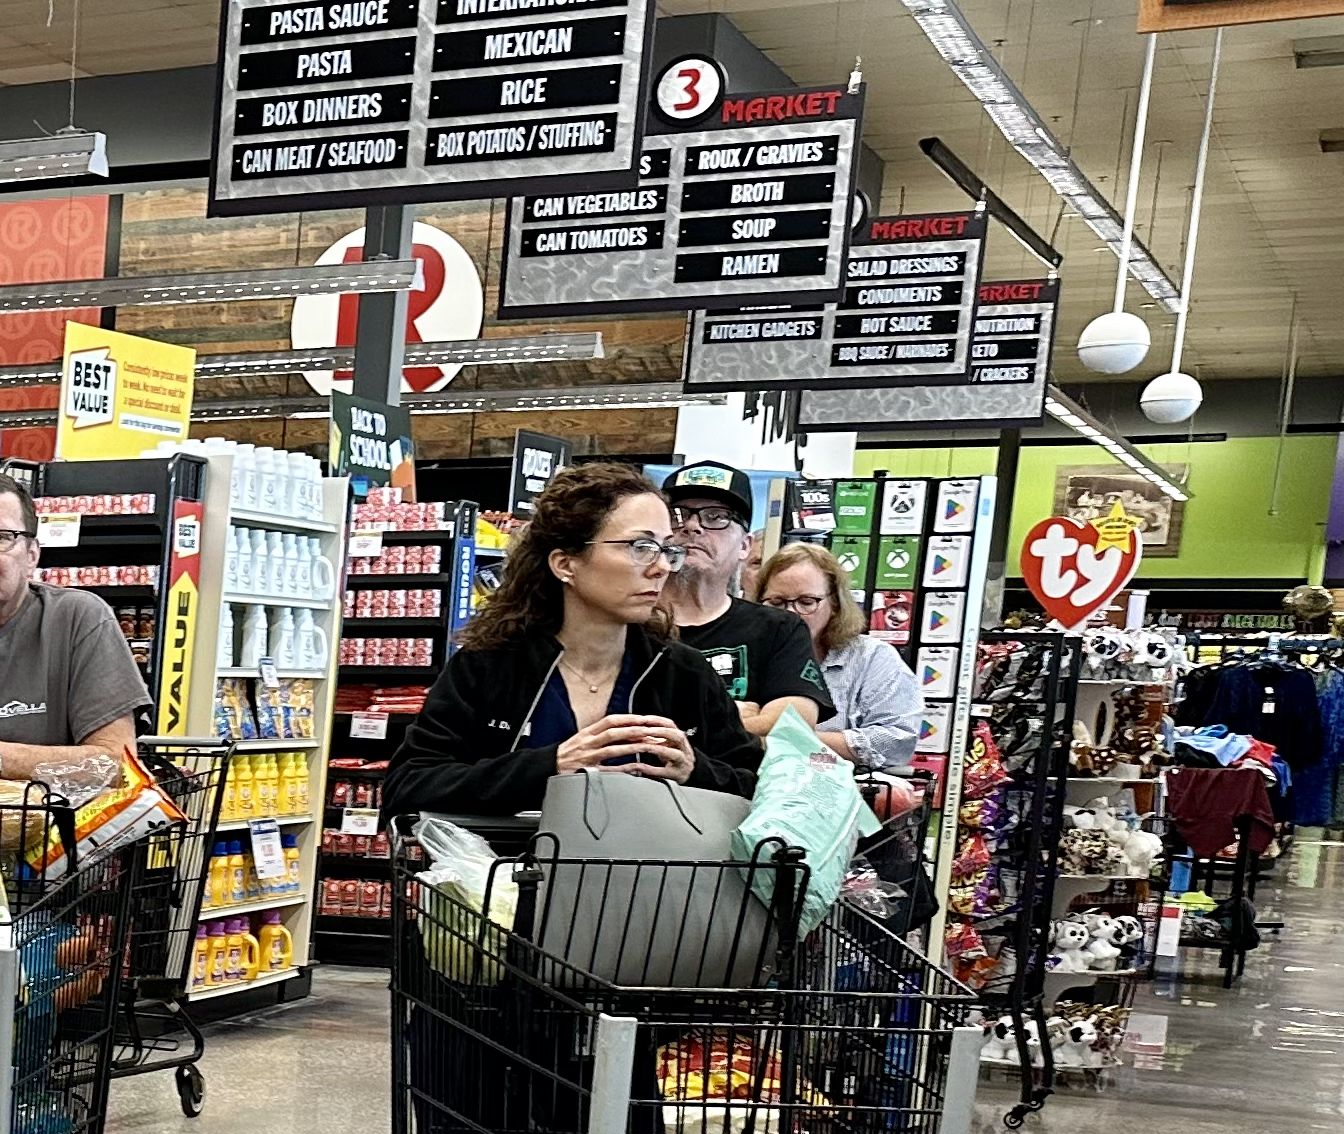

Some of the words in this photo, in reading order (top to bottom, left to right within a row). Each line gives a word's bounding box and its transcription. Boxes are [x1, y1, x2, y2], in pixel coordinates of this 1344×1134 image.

[269, 7, 325, 35] PASTA
[329, 0, 389, 29] SAUCE
[484, 27, 573, 60] MEXICAN
[296, 50, 352, 78] PASTA
[500, 77, 547, 106] RICE
[672, 68, 701, 112] 3
[262, 100, 298, 126] BOX
[301, 93, 382, 122] DINNERS
[721, 91, 843, 124] MARKET
[437, 132, 463, 158] BOX
[466, 127, 526, 154] POTATOS
[526, 125, 538, 151] /
[538, 121, 605, 149] STUFFING
[242, 150, 272, 174] CAN
[274, 145, 313, 171] MEAT
[315, 143, 326, 169] /
[328, 138, 396, 166] SEAFOOD
[698, 149, 742, 171] ROUX
[755, 142, 824, 166] GRAVIES
[533, 197, 564, 218] CAN
[566, 190, 658, 216] VEGETABLES
[730, 181, 785, 204] BROTH
[535, 232, 567, 253] CAN
[569, 227, 648, 250] TOMATOES
[732, 218, 777, 240] SOUP
[870, 216, 969, 241] MARKET
[720, 253, 780, 277] RAMEN
[848, 259, 887, 278] SALAD
[889, 256, 959, 275] DRESSINGS
[857, 285, 943, 305] CONDIMENTS
[980, 284, 1044, 301] ARKET
[709, 323, 759, 340] KITCHEN
[762, 320, 815, 338] GADGETS
[860, 317, 887, 334] HOT
[888, 315, 933, 332] SAUCE
[73, 360, 112, 391] BEST
[72, 391, 110, 415] VALUE
[350, 406, 374, 434] BACK
[373, 411, 387, 437] TO
[1030, 523, 1122, 607] ty
